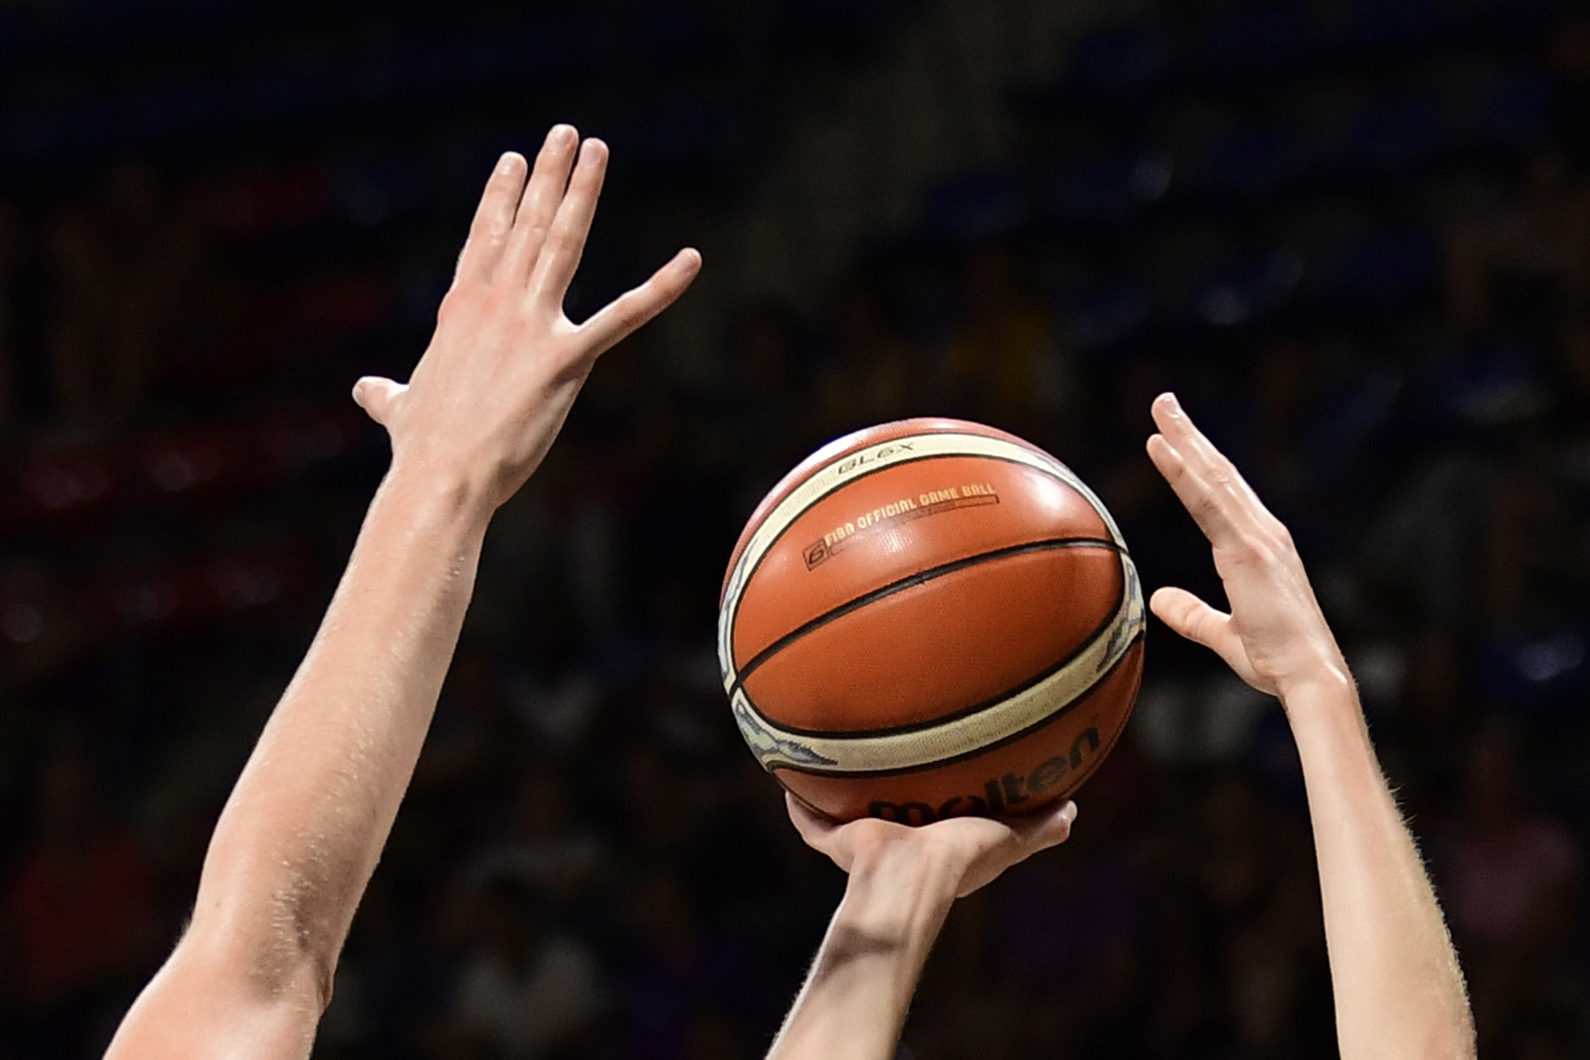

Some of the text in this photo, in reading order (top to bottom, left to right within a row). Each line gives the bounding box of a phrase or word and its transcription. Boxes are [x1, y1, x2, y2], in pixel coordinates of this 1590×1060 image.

[824, 483, 996, 547] FIBA OFFICIAL GAME BALL
[868, 728, 1100, 826] molten
